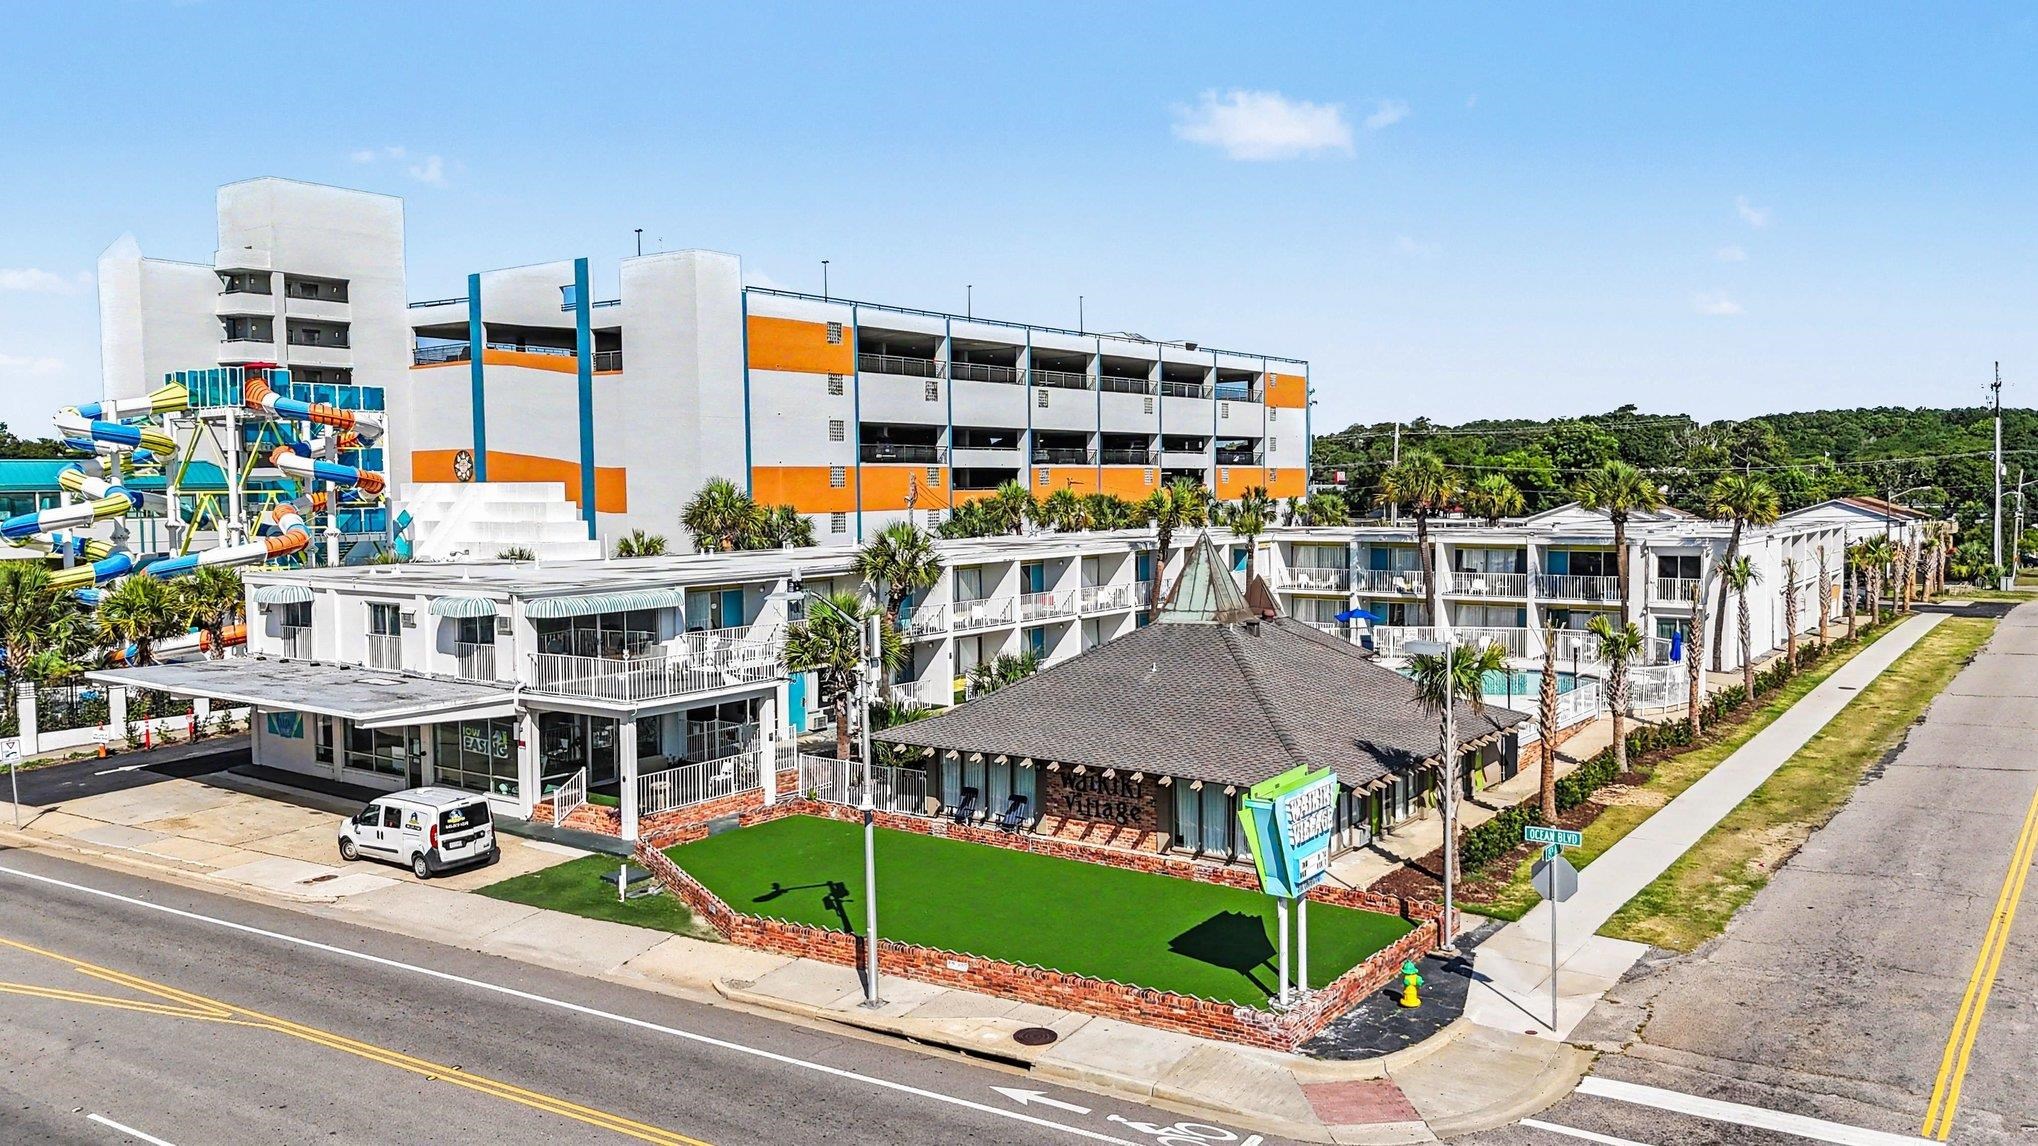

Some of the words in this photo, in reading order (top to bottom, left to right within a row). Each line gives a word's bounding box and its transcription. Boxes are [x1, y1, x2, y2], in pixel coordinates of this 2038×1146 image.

[1062, 792, 1142, 825] Village
[1288, 808, 1334, 848] VILLAGE
[1530, 828, 1555, 842] OCEAN
[1557, 832, 1578, 844] BLVD
